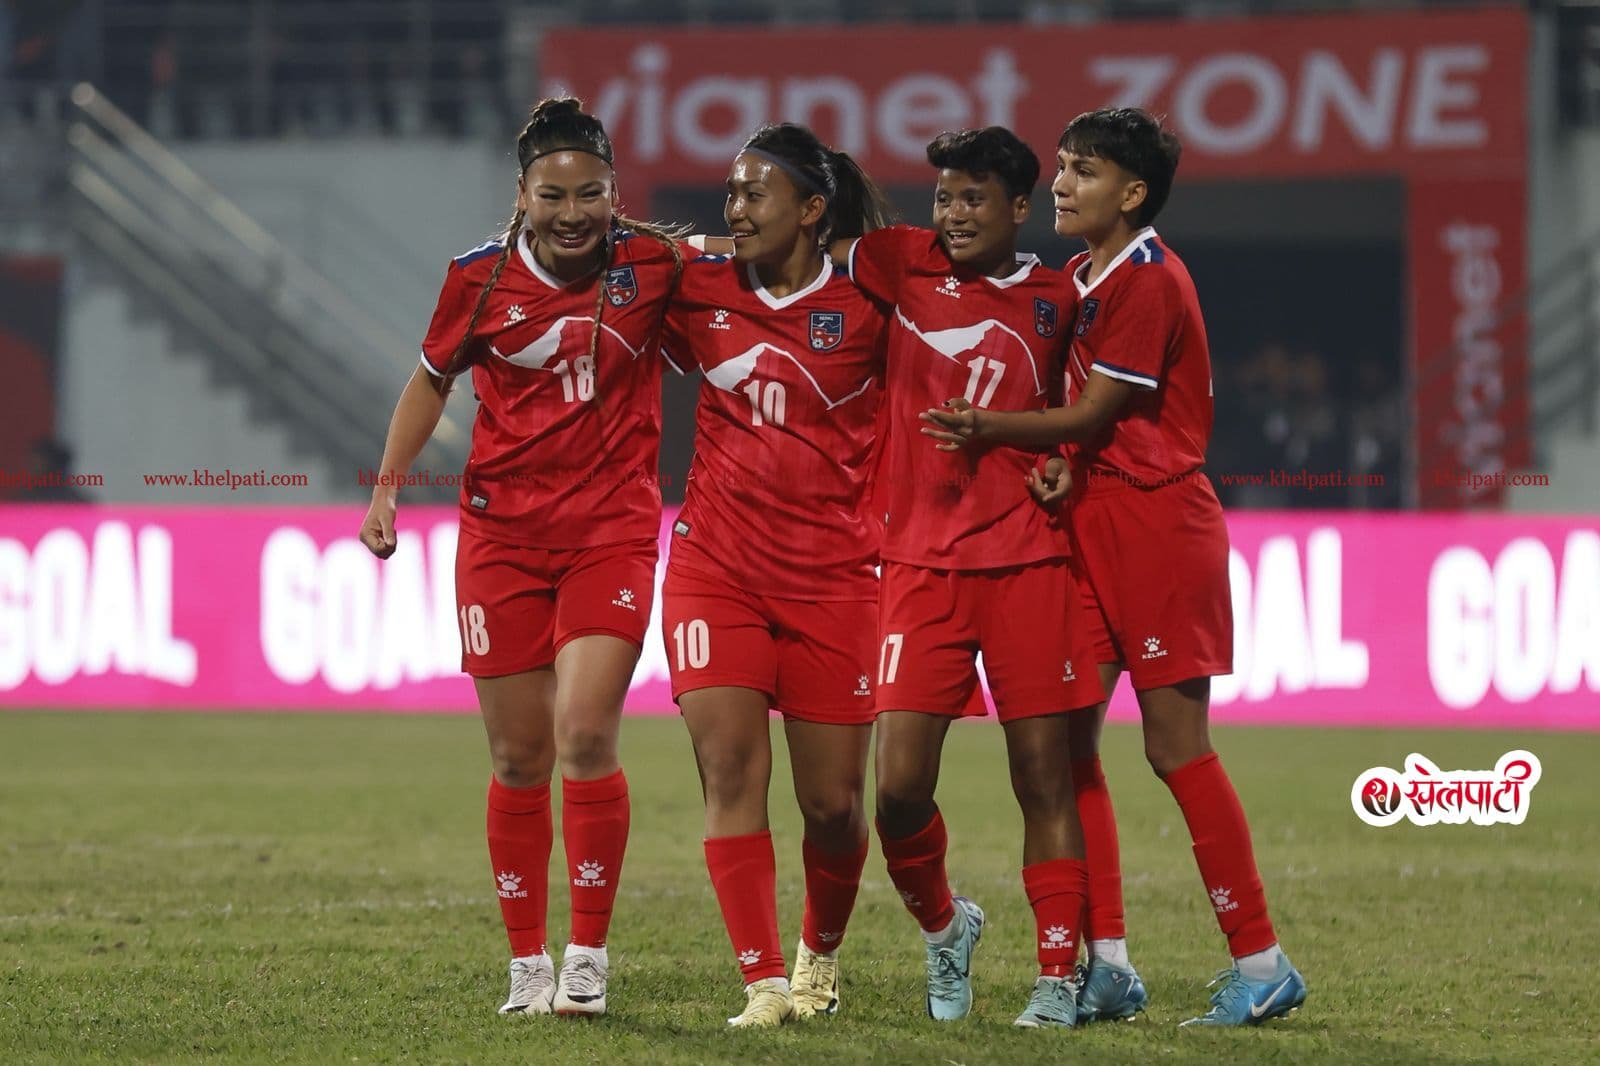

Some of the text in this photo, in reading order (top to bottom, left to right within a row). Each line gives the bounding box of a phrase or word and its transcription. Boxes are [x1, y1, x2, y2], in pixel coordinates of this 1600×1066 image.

[1089, 44, 1489, 154] ZONE
[936, 286, 961, 299] KELME
[553, 355, 595, 403] 18
[963, 355, 1006, 409] 17
[743, 380, 786, 427] 10
[612, 599, 636, 612] KELME
[461, 604, 490, 656] 18
[673, 619, 710, 672] 10
[878, 634, 904, 686] 17
[1142, 650, 1168, 660] KELME
[574, 879, 607, 887] KELME
[1041, 940, 1073, 949] KELME
